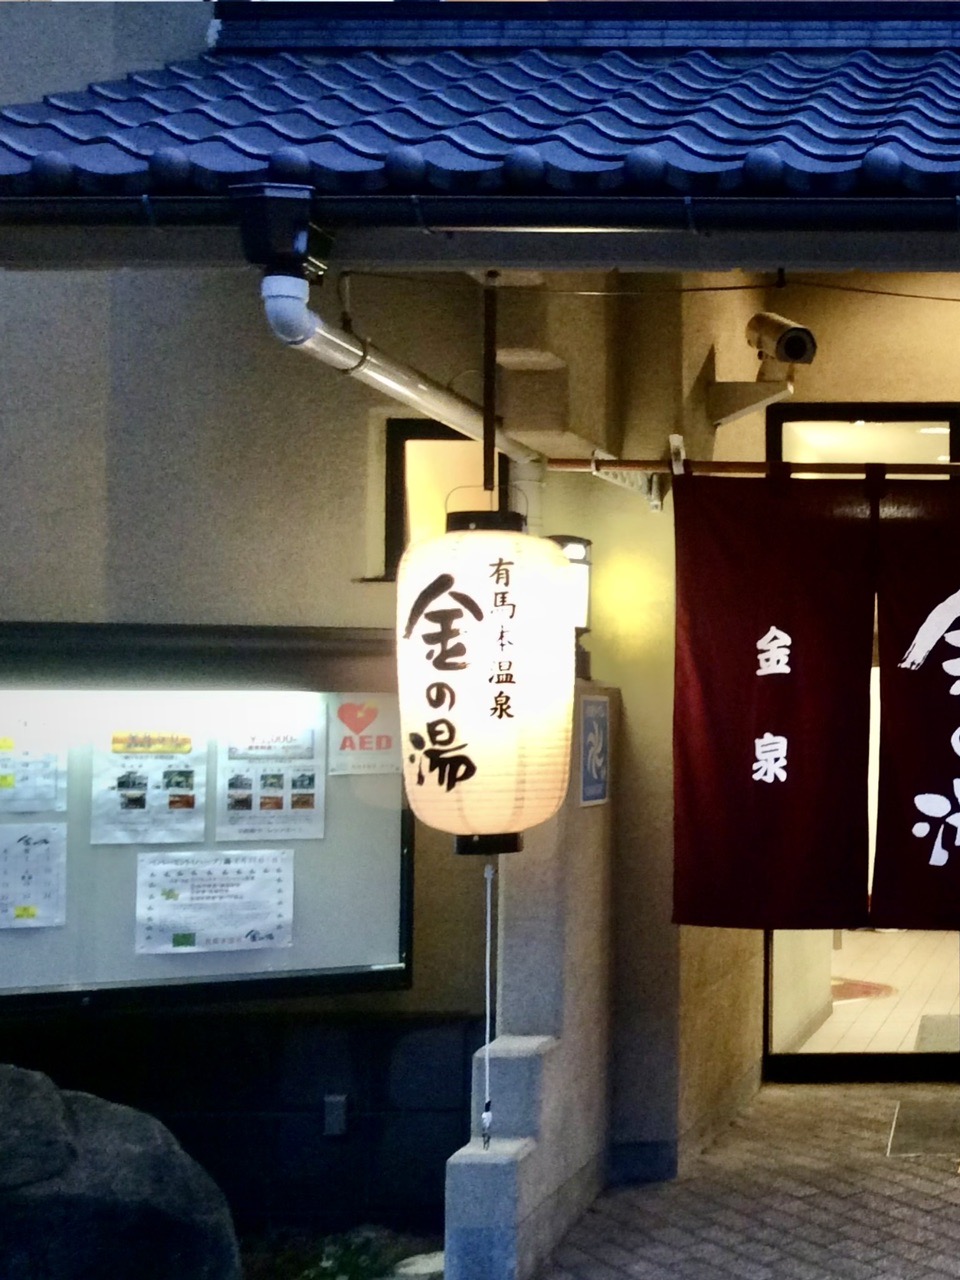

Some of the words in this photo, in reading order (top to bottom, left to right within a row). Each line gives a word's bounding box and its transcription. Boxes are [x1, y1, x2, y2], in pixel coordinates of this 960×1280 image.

[402, 573, 484, 793] 金の湯
[488, 557, 517, 719] 有馬本温泉
[751, 625, 792, 784] 金泉
[339, 735, 393, 751] AED
